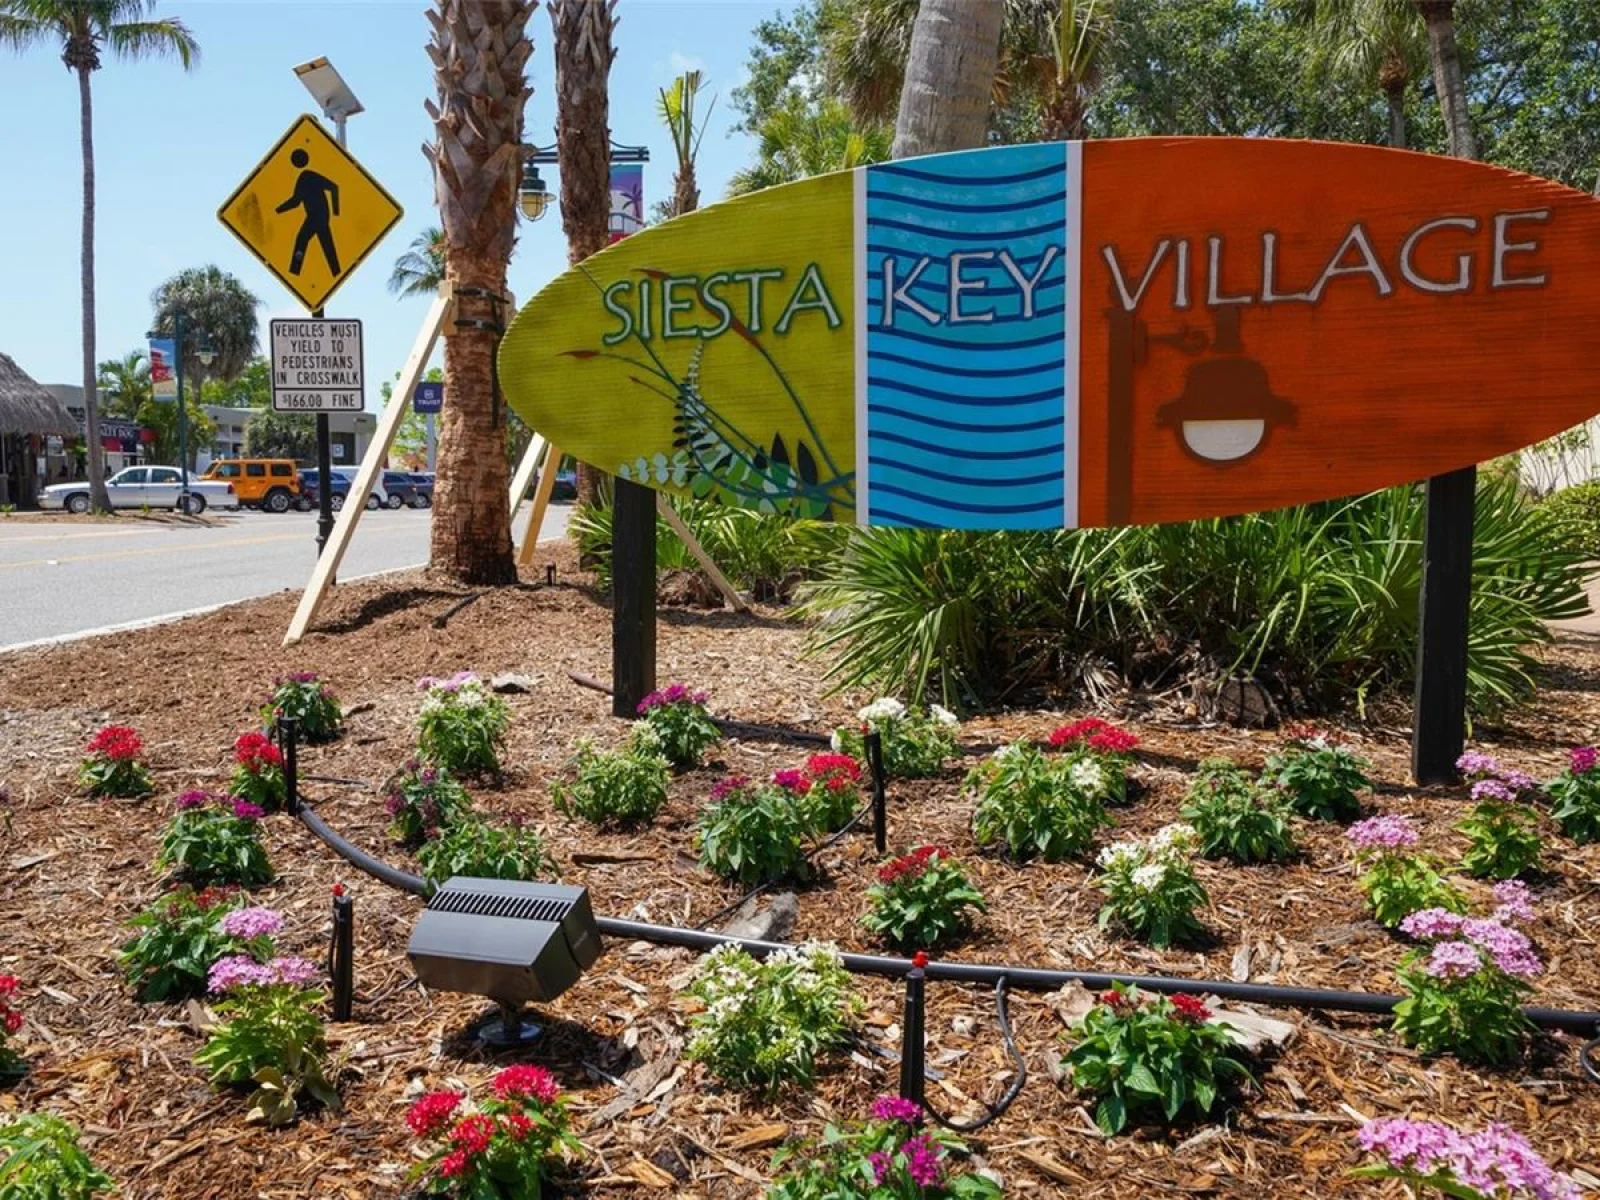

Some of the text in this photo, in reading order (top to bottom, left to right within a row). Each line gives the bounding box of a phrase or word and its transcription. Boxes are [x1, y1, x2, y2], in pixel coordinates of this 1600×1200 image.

[602, 206, 1551, 346] SIESTA KEY VILLAGE
[275, 323, 358, 337] VEHICLES MUST
[291, 340, 344, 353] YIELD TO
[282, 355, 354, 369] PEDESTRIANS
[276, 371, 360, 385] IN CROSSWALK
[283, 394, 355, 408] $166.00 FINE
